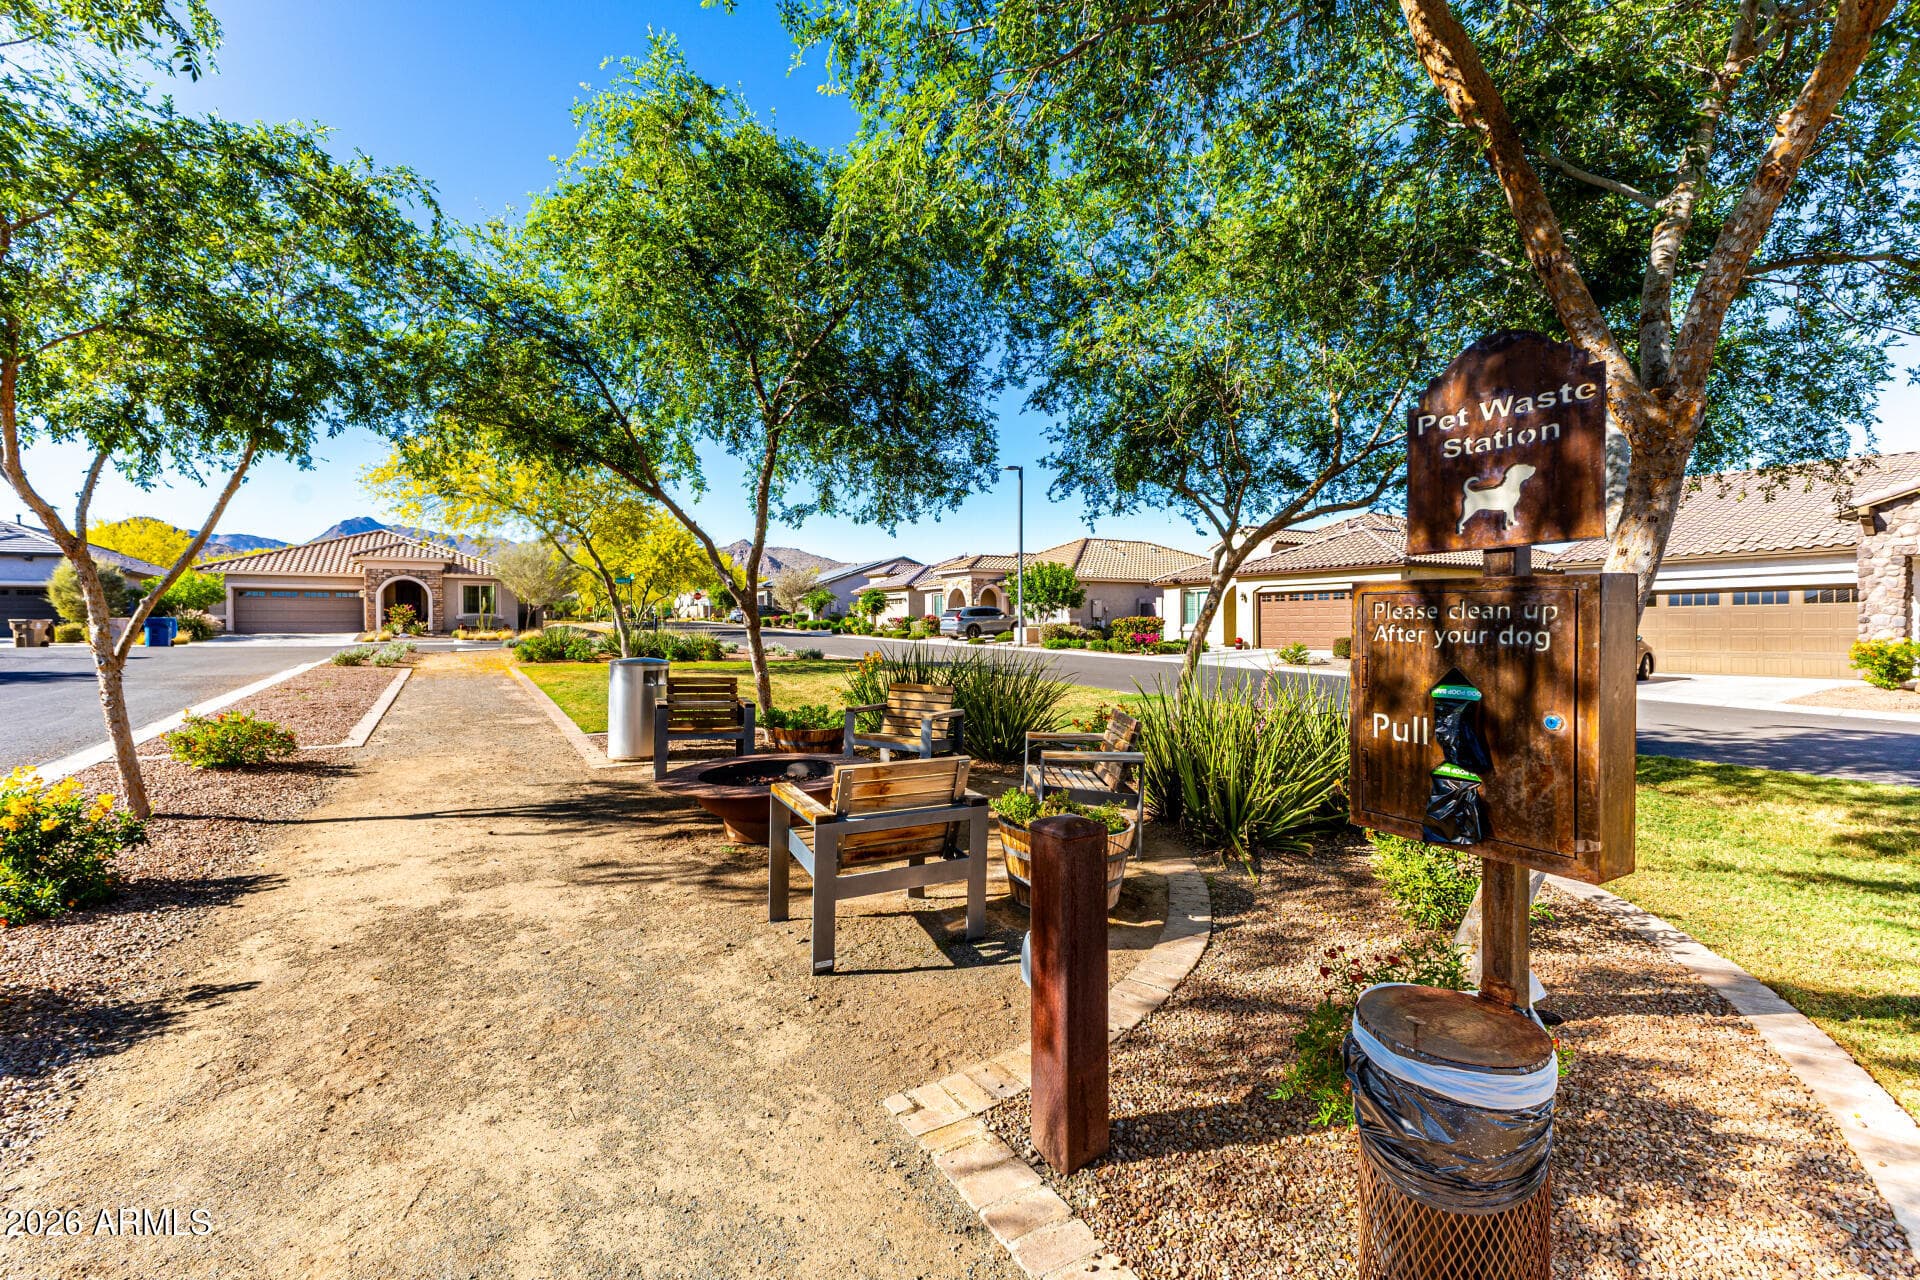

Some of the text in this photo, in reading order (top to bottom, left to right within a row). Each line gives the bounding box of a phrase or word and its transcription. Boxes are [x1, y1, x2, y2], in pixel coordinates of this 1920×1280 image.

[1418, 383, 1597, 436] Pet Waste
[1443, 422, 1560, 458] Station
[1373, 600, 1558, 625] Please clean up
[1373, 624, 1550, 651] After your dog
[1373, 712, 1428, 745] Pull
